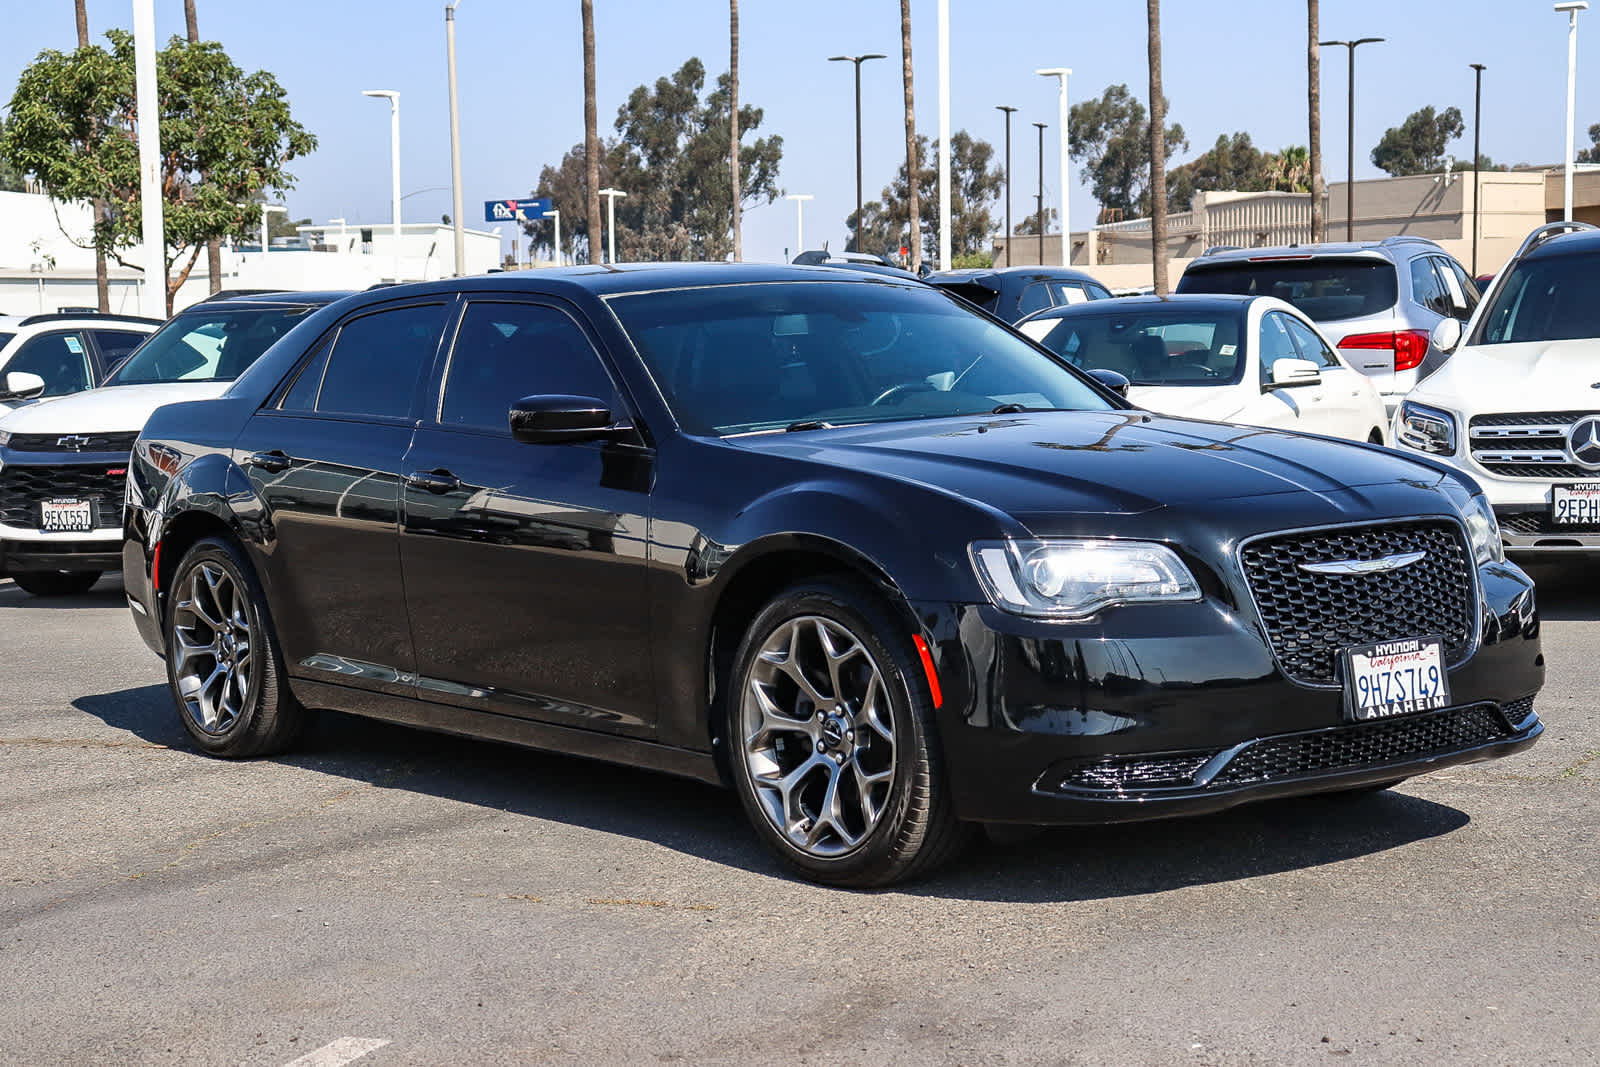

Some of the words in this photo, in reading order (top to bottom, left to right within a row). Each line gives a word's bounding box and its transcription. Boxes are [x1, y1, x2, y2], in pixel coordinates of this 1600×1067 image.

[1558, 499, 1598, 517] 9EPH
[45, 510, 88, 526] 9EKT557
[1375, 640, 1418, 656] HYUNDAI
[1370, 652, 1426, 670] California
[1359, 665, 1439, 708] 9HZS749
[1367, 695, 1445, 718] ANAHEIM
